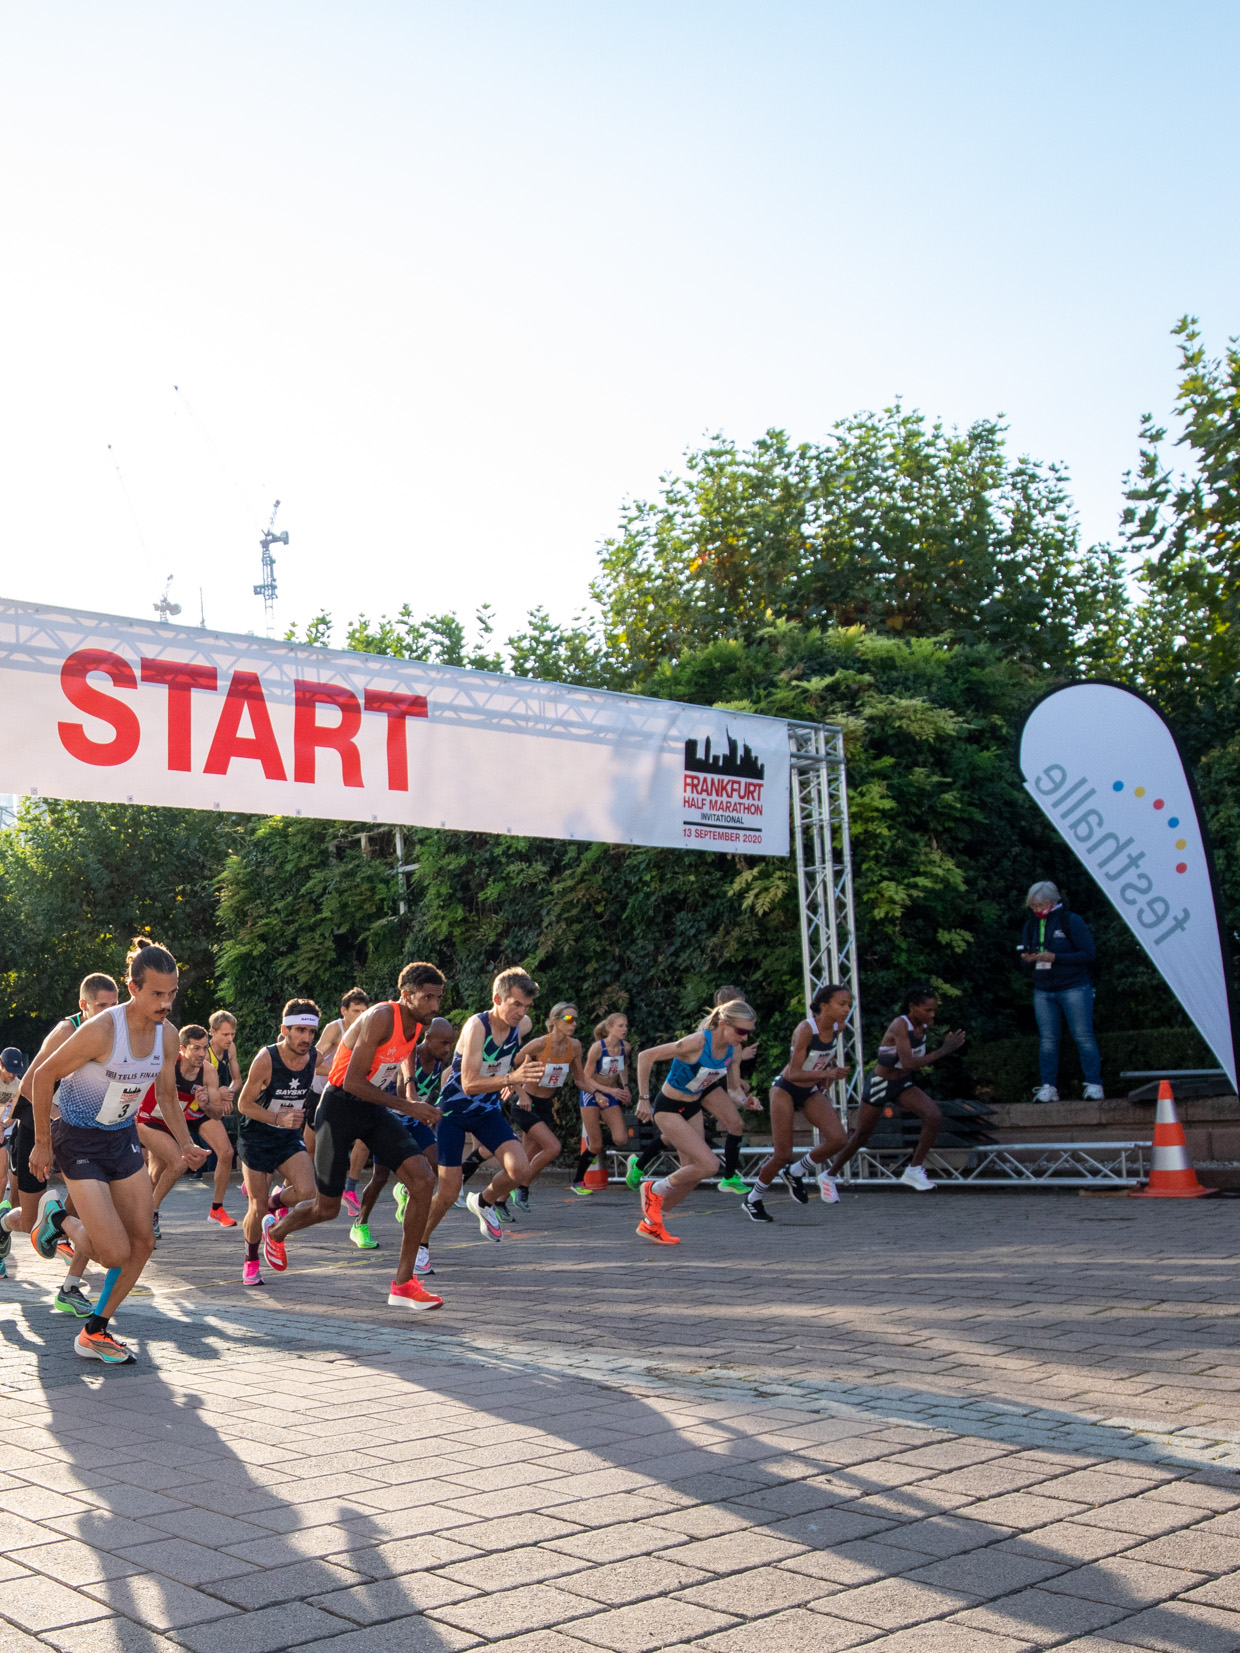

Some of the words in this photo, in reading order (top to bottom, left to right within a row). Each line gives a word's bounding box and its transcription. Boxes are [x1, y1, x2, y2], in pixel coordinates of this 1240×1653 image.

[57, 648, 429, 792] START
[683, 774, 764, 801] FRANKFURT
[683, 796, 706, 810] HALF
[709, 799, 763, 816] MARATHON
[700, 812, 744, 825] INVITATIONAL
[682, 828, 692, 838] 13
[694, 829, 741, 842] SEPTEMBER
[743, 834, 762, 844] 2020
[608, 1066, 619, 1075] F6
[547, 1075, 560, 1085] F5
[118, 1104, 130, 1119] 3
